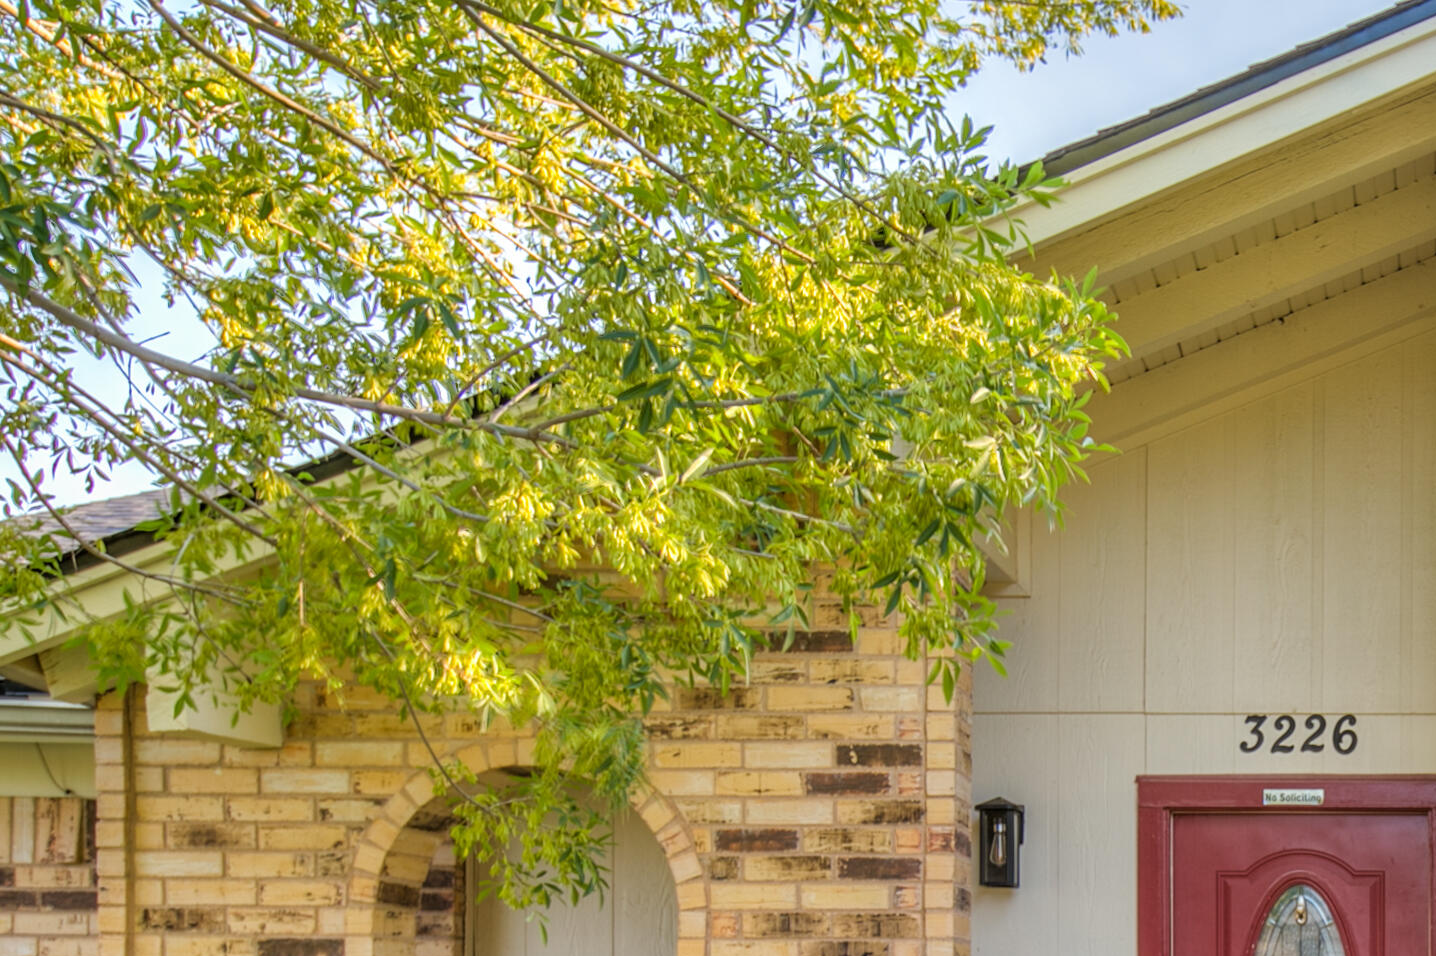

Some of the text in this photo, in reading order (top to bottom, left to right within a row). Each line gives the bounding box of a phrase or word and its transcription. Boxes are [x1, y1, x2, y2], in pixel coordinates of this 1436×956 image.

[1240, 714, 1358, 755] 3226
[1265, 792, 1321, 803] No Soliciting
